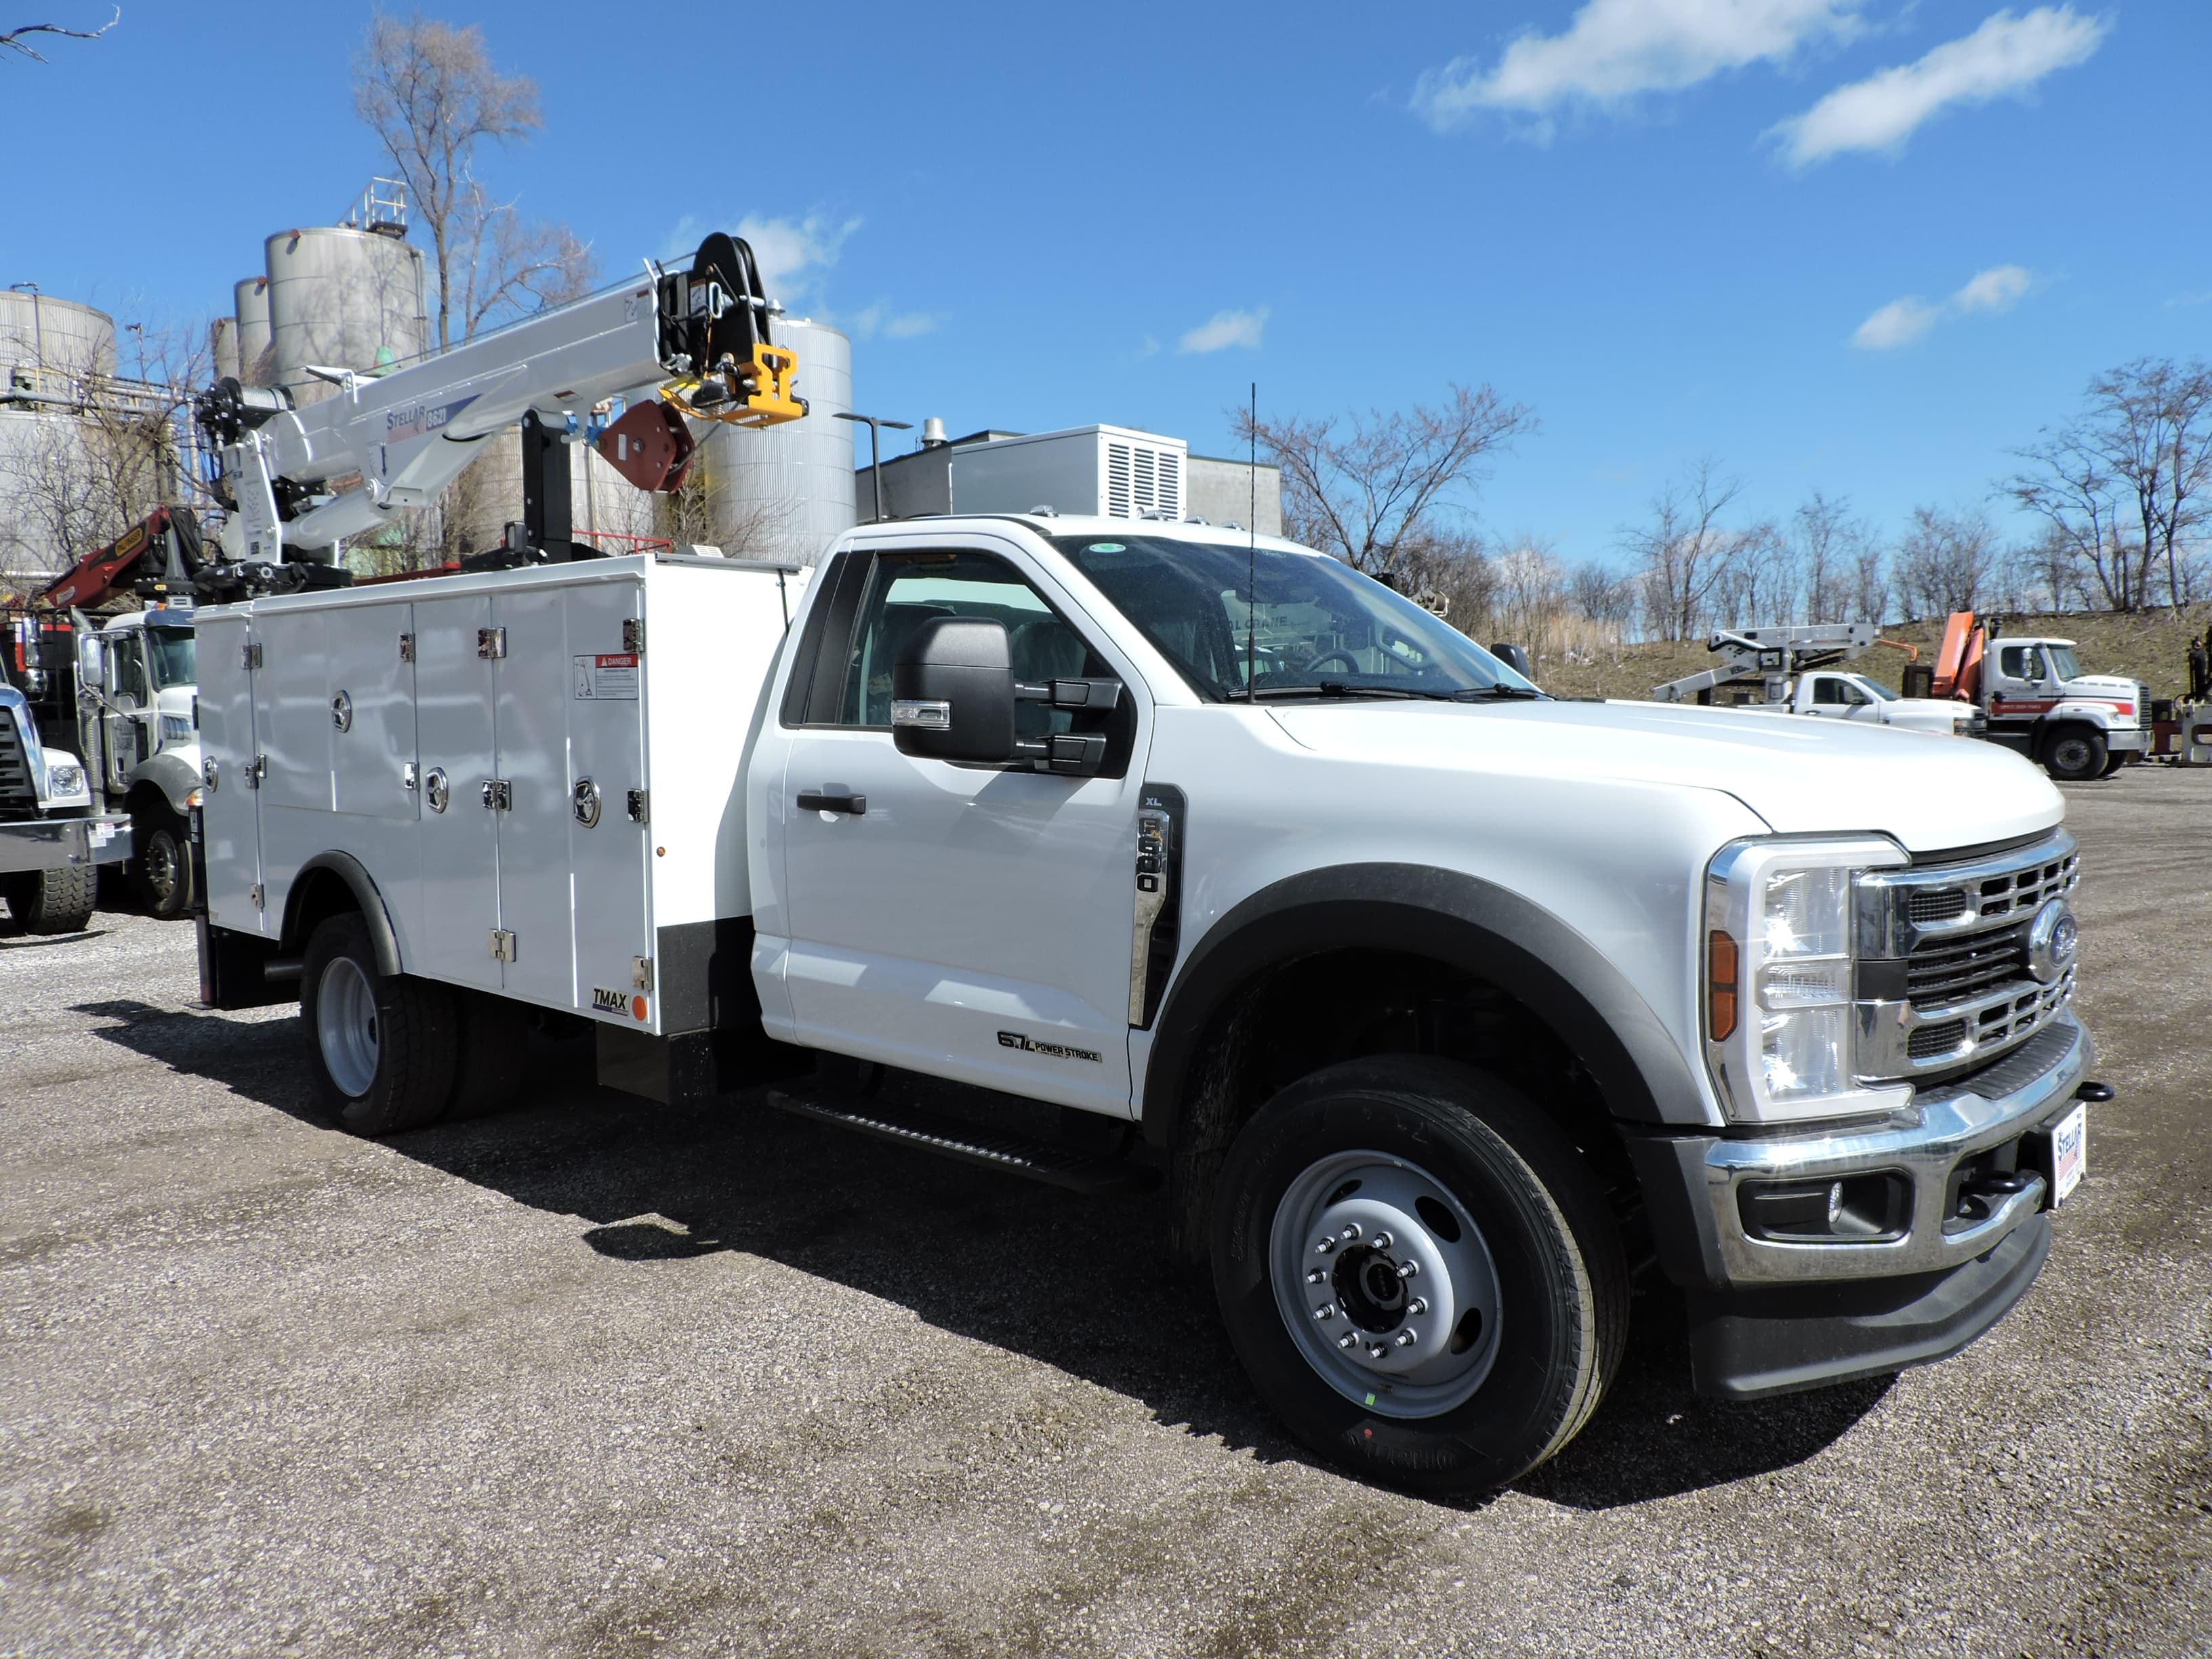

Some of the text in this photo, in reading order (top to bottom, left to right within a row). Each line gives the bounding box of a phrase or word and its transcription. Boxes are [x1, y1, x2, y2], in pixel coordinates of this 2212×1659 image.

[387, 406, 447, 430] STELLAR 8621
[608, 657, 632, 666] DANGER
[1145, 797, 1162, 806] XL
[593, 988, 627, 1009] TMAX
[997, 1031, 1035, 1052] 6.7L
[1036, 1042, 1063, 1055] POWER
[1065, 1049, 1099, 1062] STROKE
